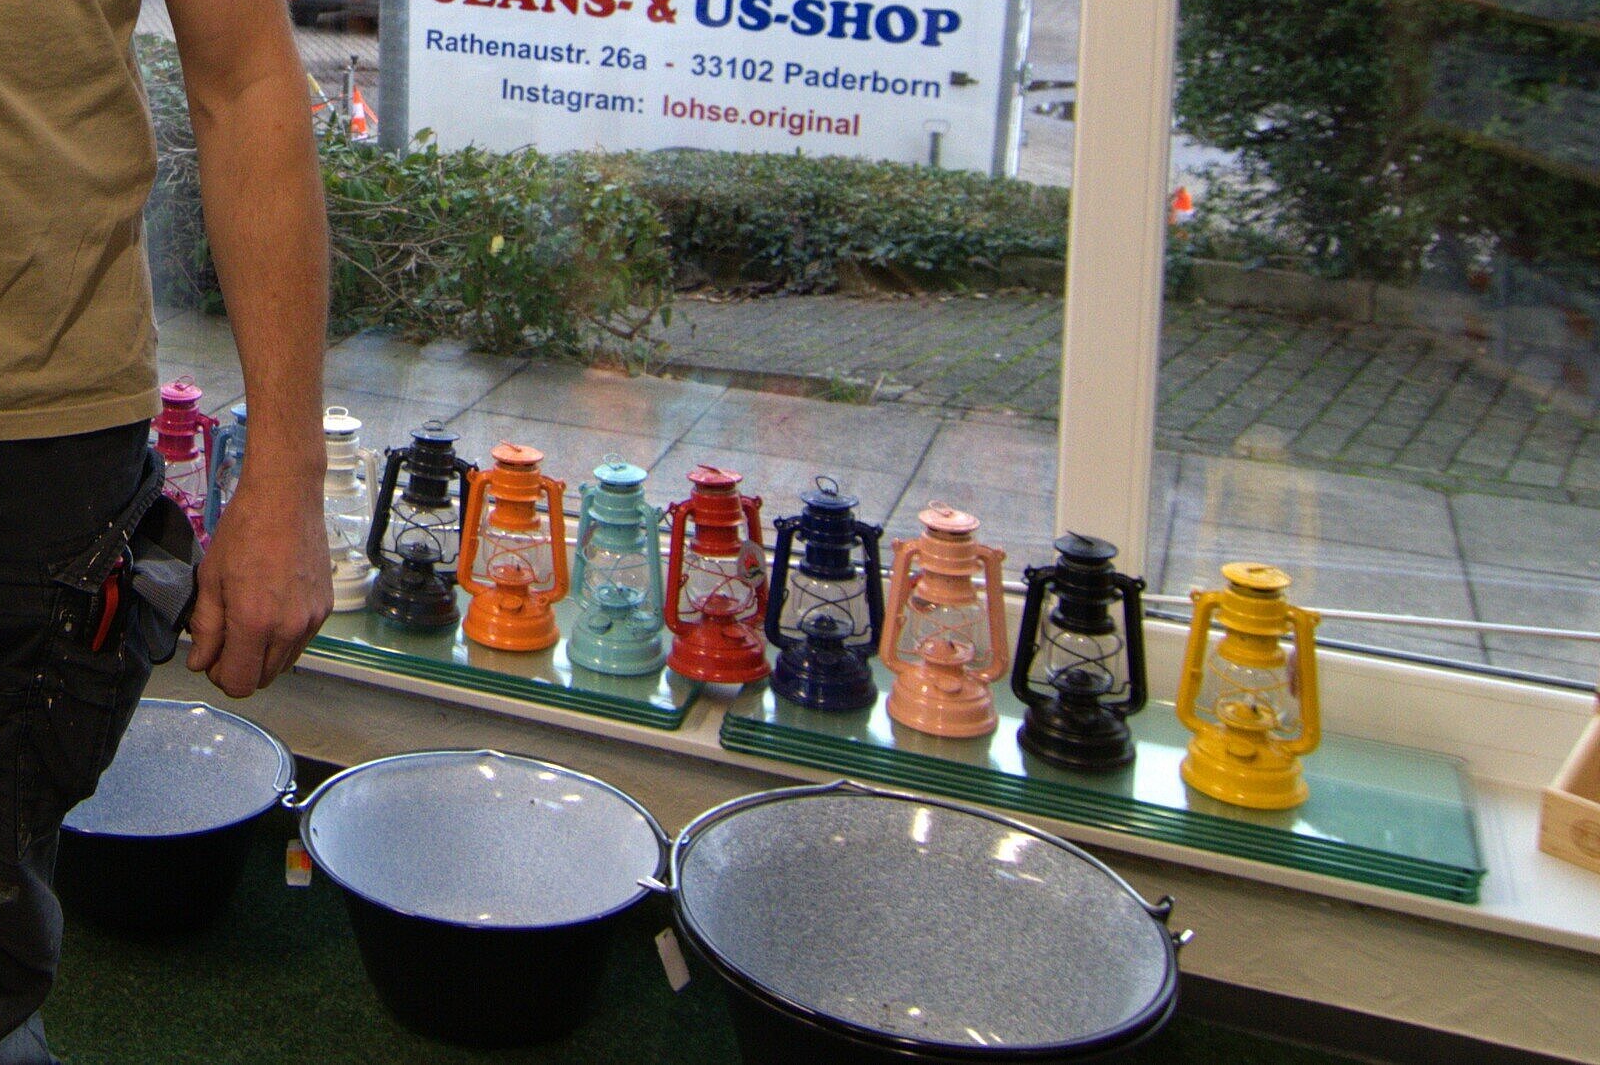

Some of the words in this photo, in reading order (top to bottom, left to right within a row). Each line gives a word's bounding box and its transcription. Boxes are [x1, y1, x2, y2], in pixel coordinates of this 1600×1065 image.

[426, 29, 591, 66] Rathenaustr.
[600, 45, 648, 71] 26a
[691, 54, 774, 83] 33102
[784, 62, 941, 98] Paderborn
[501, 78, 644, 116] Instagram:
[662, 94, 860, 137] lohse.original
